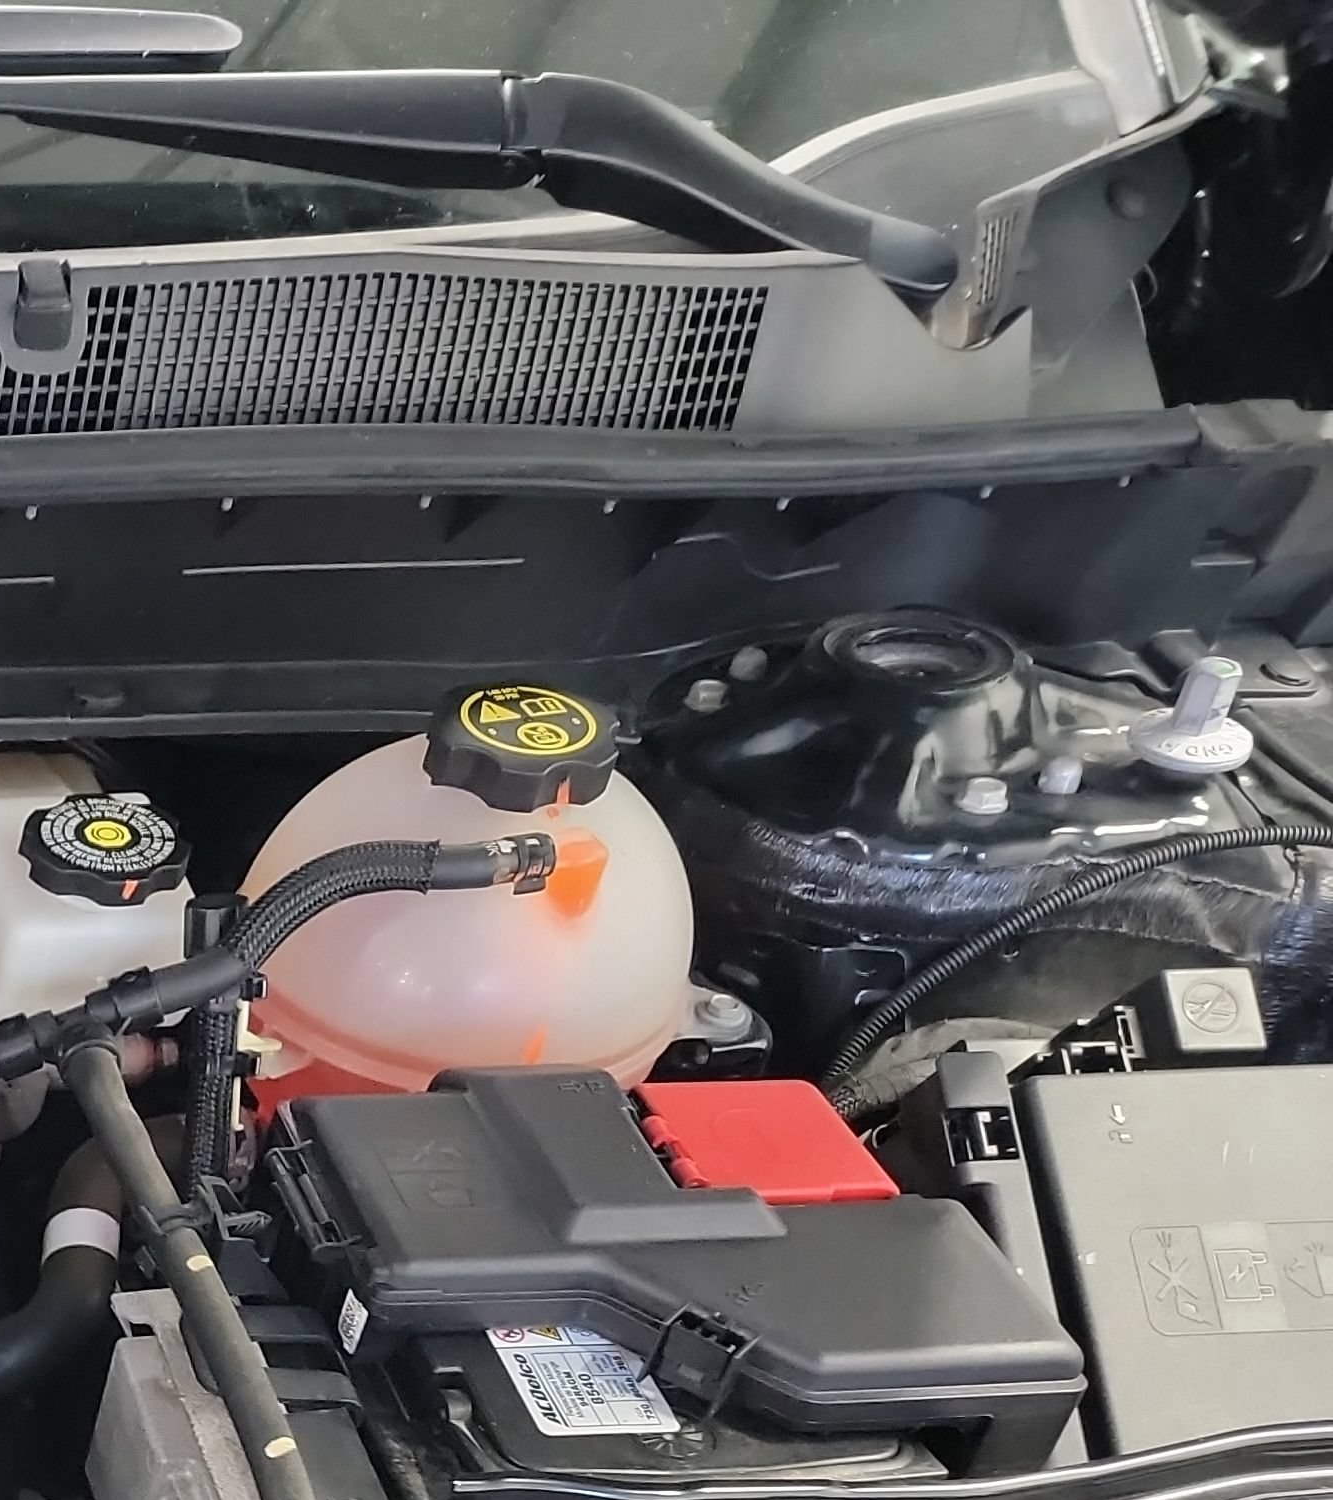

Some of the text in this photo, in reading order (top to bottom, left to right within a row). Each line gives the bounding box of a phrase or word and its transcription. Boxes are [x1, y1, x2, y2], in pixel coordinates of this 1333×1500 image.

[512, 1353, 561, 1424] ACDelco
[576, 1373, 605, 1404] 8540
[639, 1403, 655, 1419] 730
